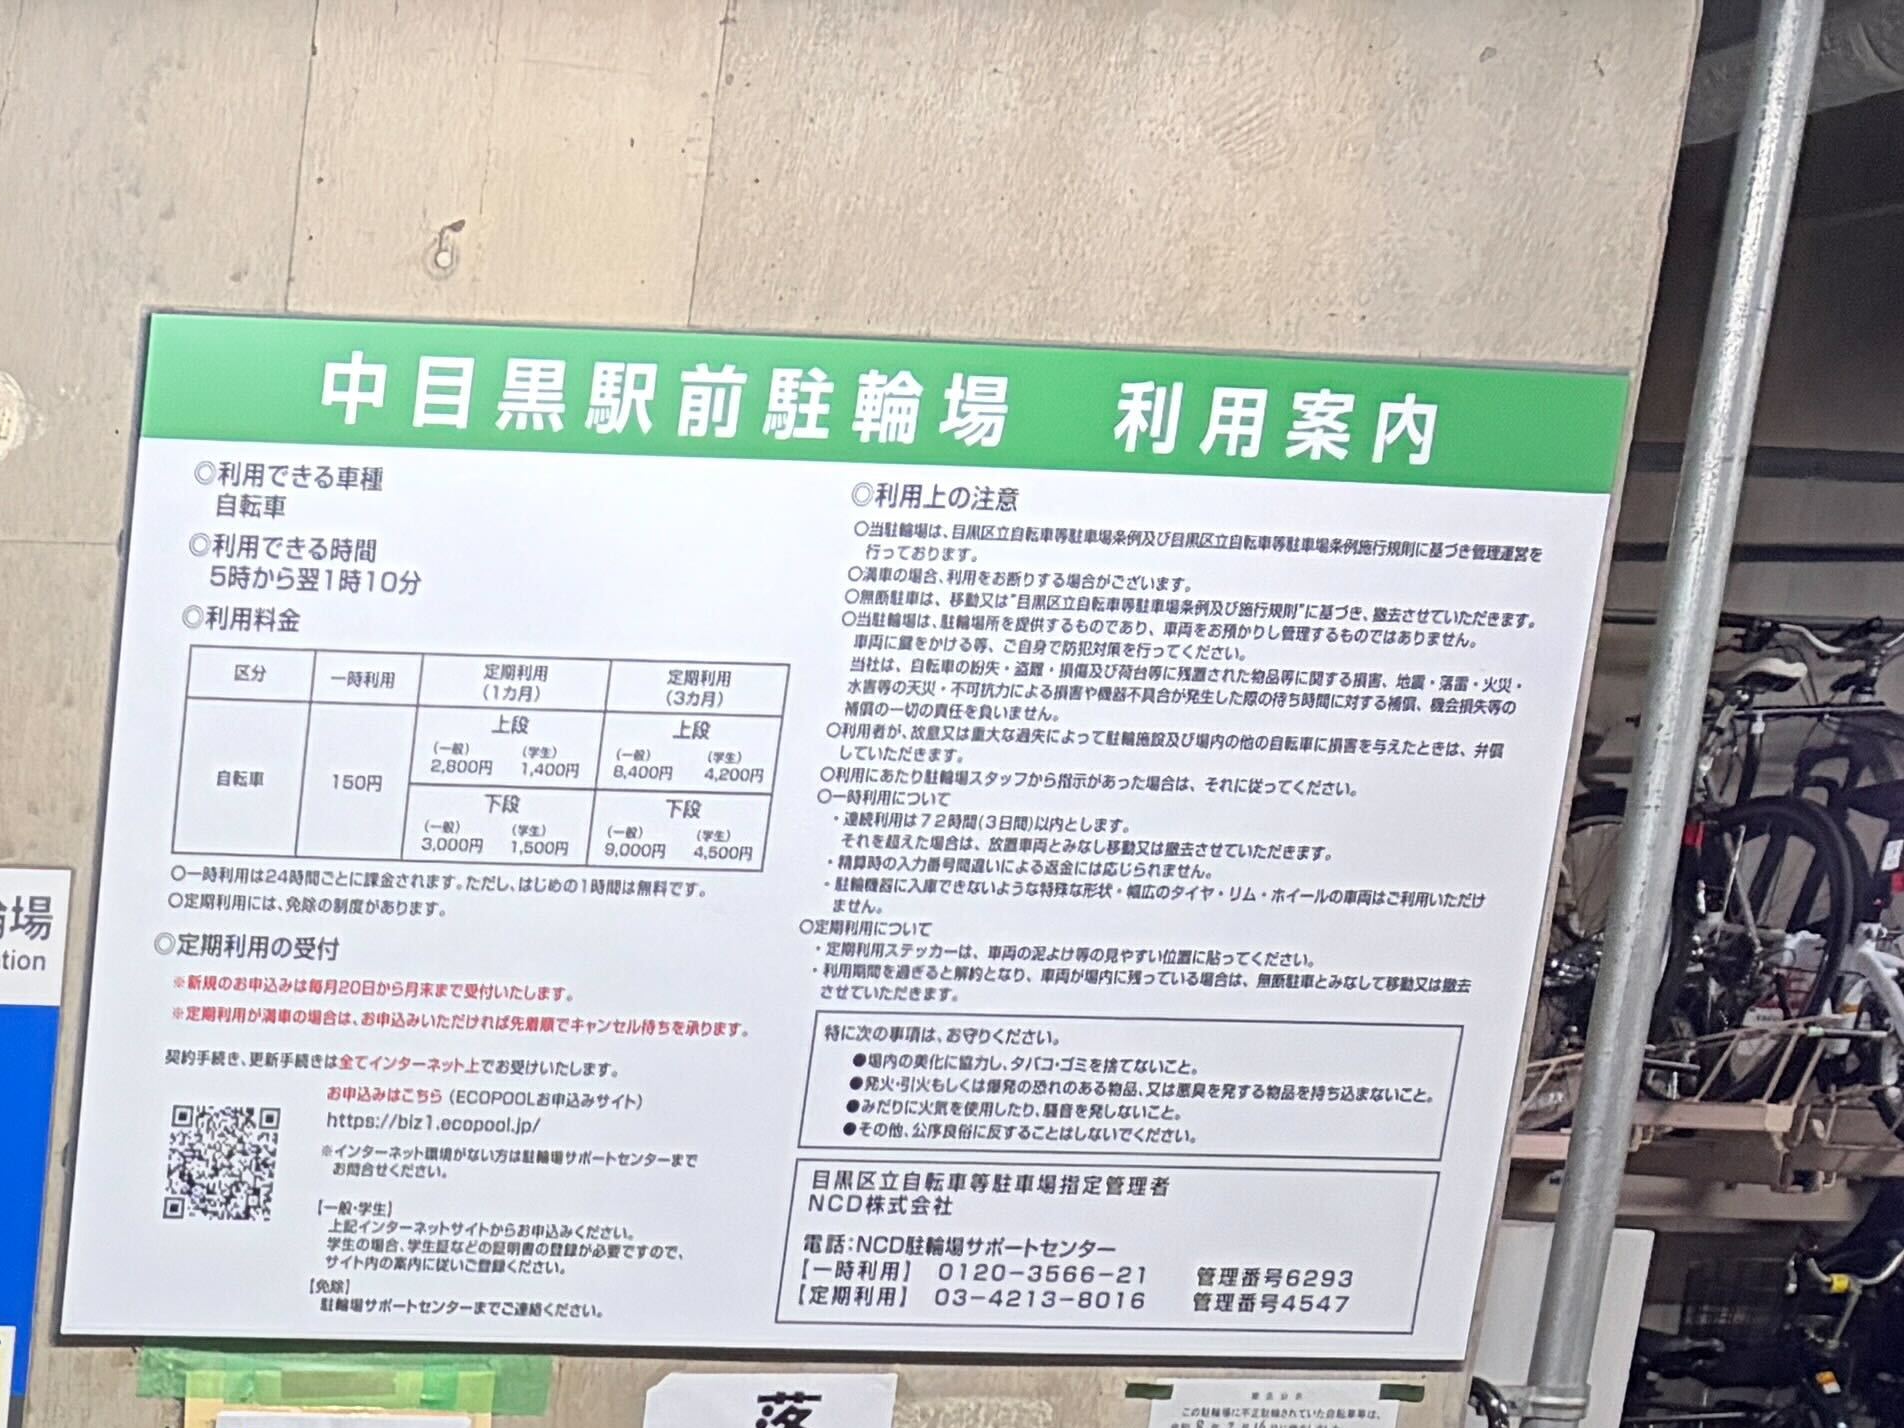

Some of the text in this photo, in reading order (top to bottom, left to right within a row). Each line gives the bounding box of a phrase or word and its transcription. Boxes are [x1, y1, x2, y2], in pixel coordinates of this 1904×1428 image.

[319, 347, 1439, 466] 中目黒駅前駐輪場 利用案内
[215, 494, 287, 520] 自転車
[209, 564, 422, 597] 5時から翌1時10分
[234, 663, 267, 683] 区分
[330, 672, 396, 691] 一時利用
[483, 662, 549, 684] 定期利用
[667, 668, 732, 689] 定期利用
[493, 714, 529, 735] 上段
[673, 719, 710, 741] 上段
[430, 758, 493, 778] 2,800円
[521, 761, 580, 780] 1,400円
[613, 764, 673, 783] 8,400円
[704, 766, 764, 786] 4,200円
[215, 769, 265, 789] 自転車
[331, 773, 383, 793] 150円
[484, 793, 521, 815] 下段
[666, 799, 702, 820] 下段
[421, 836, 484, 855] 3,000円
[510, 839, 569, 858] 1,500円
[604, 841, 666, 861] 9,000円
[693, 843, 754, 863] 4,500円
[832, 898, 883, 915] ません。
[326, 1084, 443, 1106] お申込みはこちら
[326, 1111, 541, 1136] https://biz1.ecopool.jp/
[812, 1169, 1170, 1198] 目黒区立自転車等駐車場指定管理者
[807, 1193, 954, 1217] NCD株式会社
[938, 1262, 1147, 1285] 0120-3566-21
[1197, 1266, 1354, 1289] 管理番号6293
[934, 1287, 1146, 1311] 03-4213-8016
[1193, 1290, 1351, 1314] 管理番号4547
